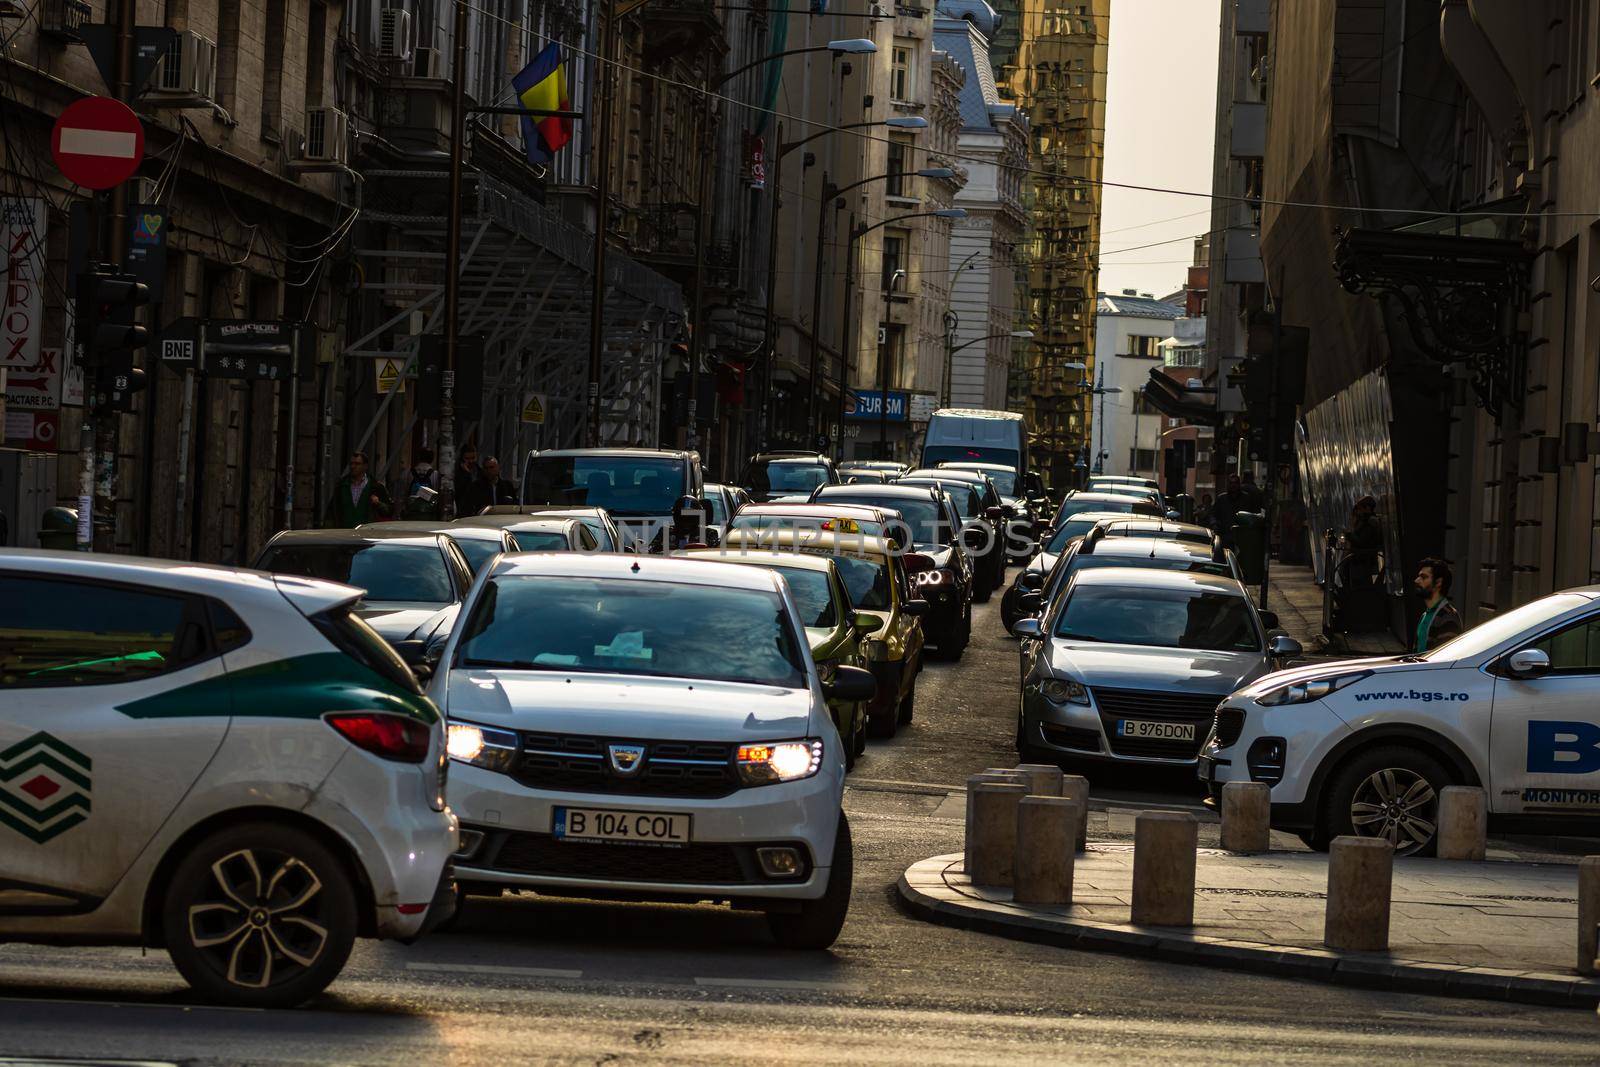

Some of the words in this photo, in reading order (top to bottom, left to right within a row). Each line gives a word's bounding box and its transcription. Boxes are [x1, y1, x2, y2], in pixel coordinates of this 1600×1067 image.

[6, 231, 32, 361] XEROX
[164, 341, 191, 358] BNE
[859, 396, 902, 415] TURSM
[1355, 689, 1469, 702] www.bgs.ro
[1125, 721, 1135, 735] B
[570, 812, 586, 834] B
[595, 813, 629, 837] 104
[635, 815, 681, 839] COL
